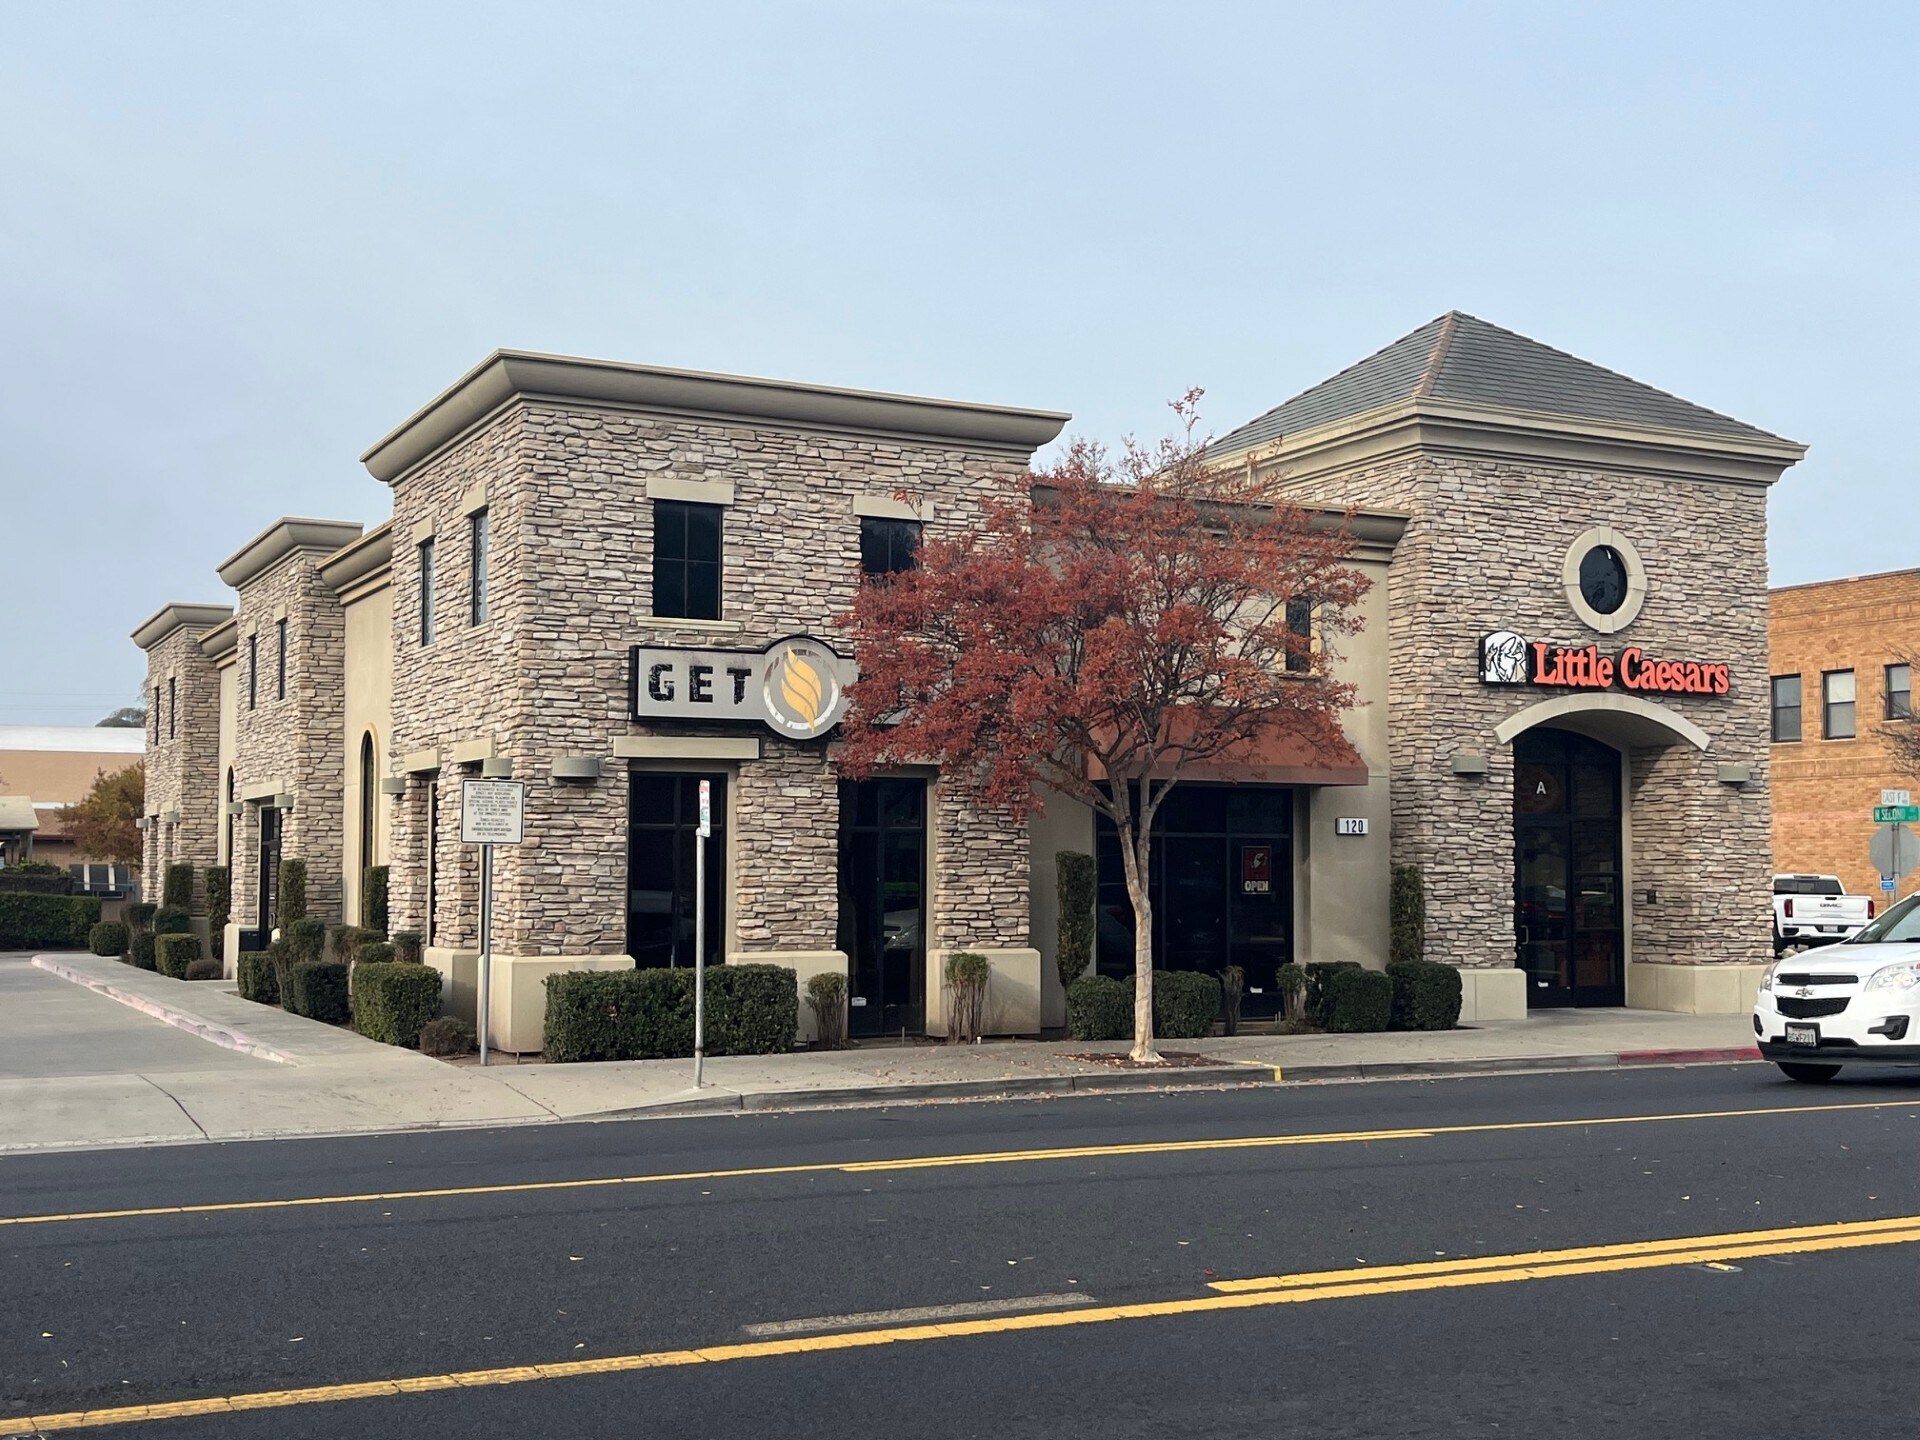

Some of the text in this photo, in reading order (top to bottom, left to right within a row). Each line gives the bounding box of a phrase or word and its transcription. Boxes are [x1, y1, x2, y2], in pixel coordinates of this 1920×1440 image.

[1532, 641, 1730, 694] Little Caesars
[648, 663, 752, 705] GET
[1536, 781, 1546, 795] A
[1875, 808, 1906, 821] N SECOND
[1345, 819, 1364, 833] 120
[1244, 880, 1269, 892] OPEN
